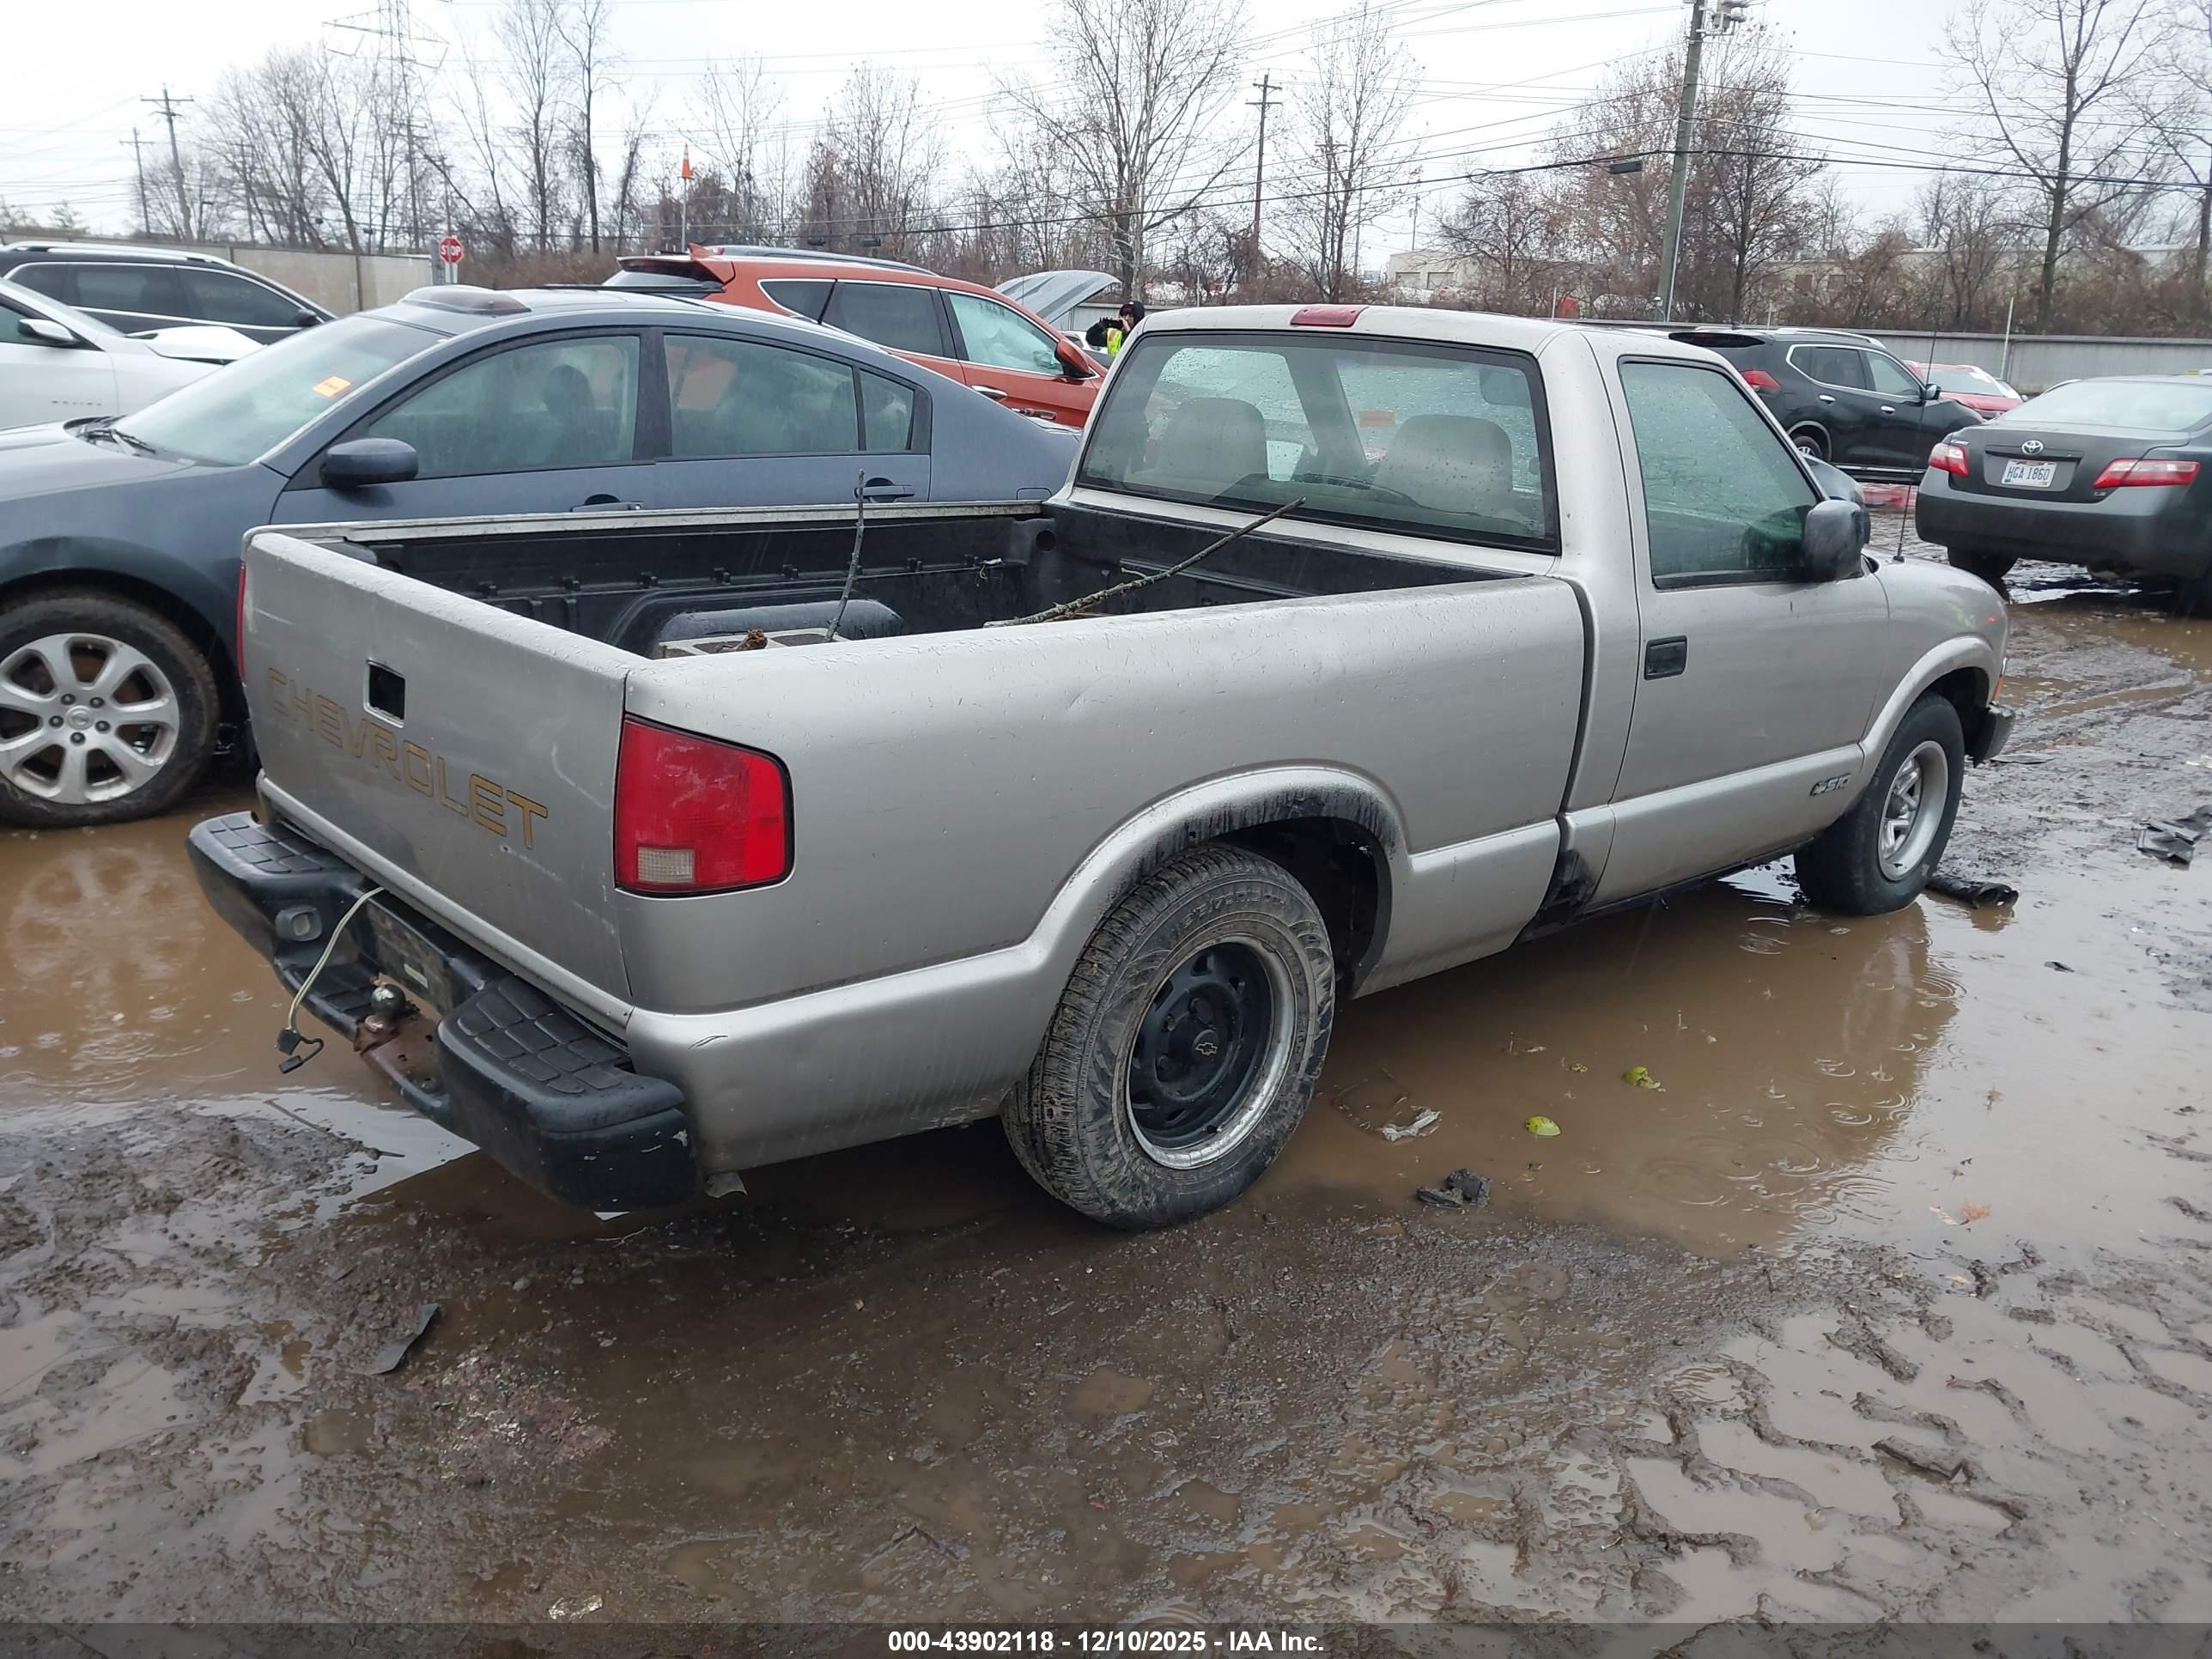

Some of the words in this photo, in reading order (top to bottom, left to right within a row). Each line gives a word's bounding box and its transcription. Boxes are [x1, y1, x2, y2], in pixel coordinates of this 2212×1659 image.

[441, 244, 461, 256] STOP
[2006, 466, 2025, 479] HGA
[2026, 467, 2051, 481] 1860
[267, 666, 549, 850] CHEVROLET
